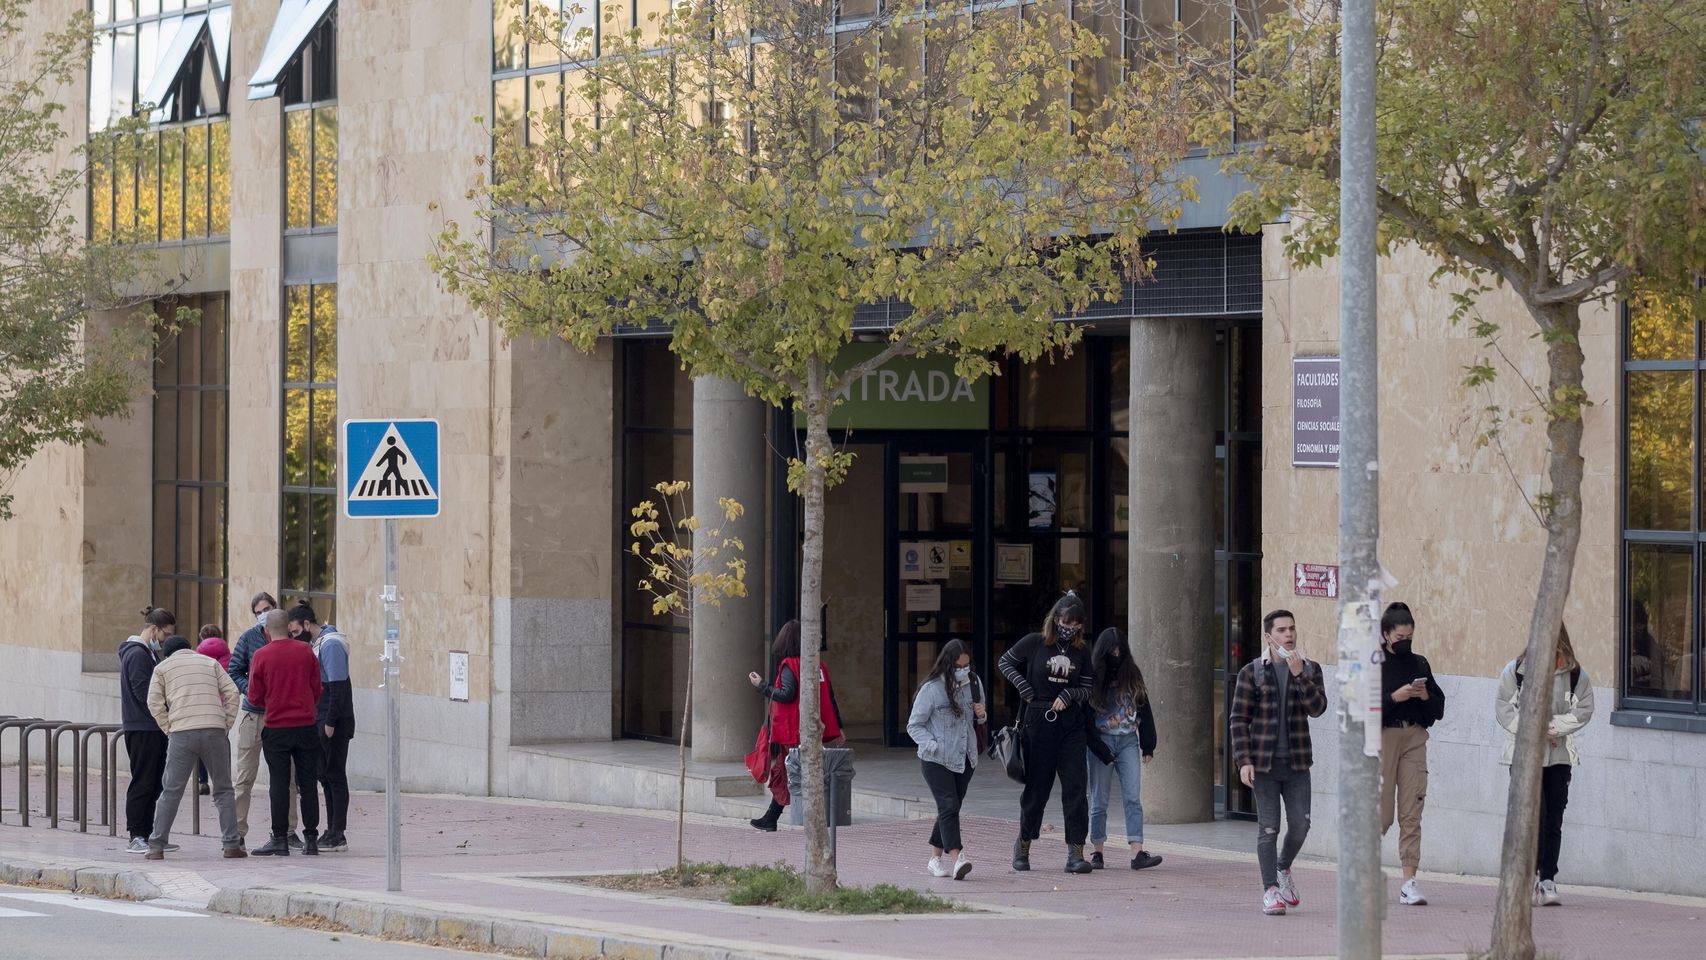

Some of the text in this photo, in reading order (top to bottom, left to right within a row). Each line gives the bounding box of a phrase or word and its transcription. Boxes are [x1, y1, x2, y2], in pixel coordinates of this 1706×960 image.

[830, 369, 975, 400] NTRADA
[1297, 373, 1338, 386] FACULTADES
[1297, 395, 1321, 408] FILOSOFÍA
[1297, 421, 1340, 432] CIENCIAS SOCIALE
[1297, 441, 1341, 454] ECONOMÍA Y EMP
